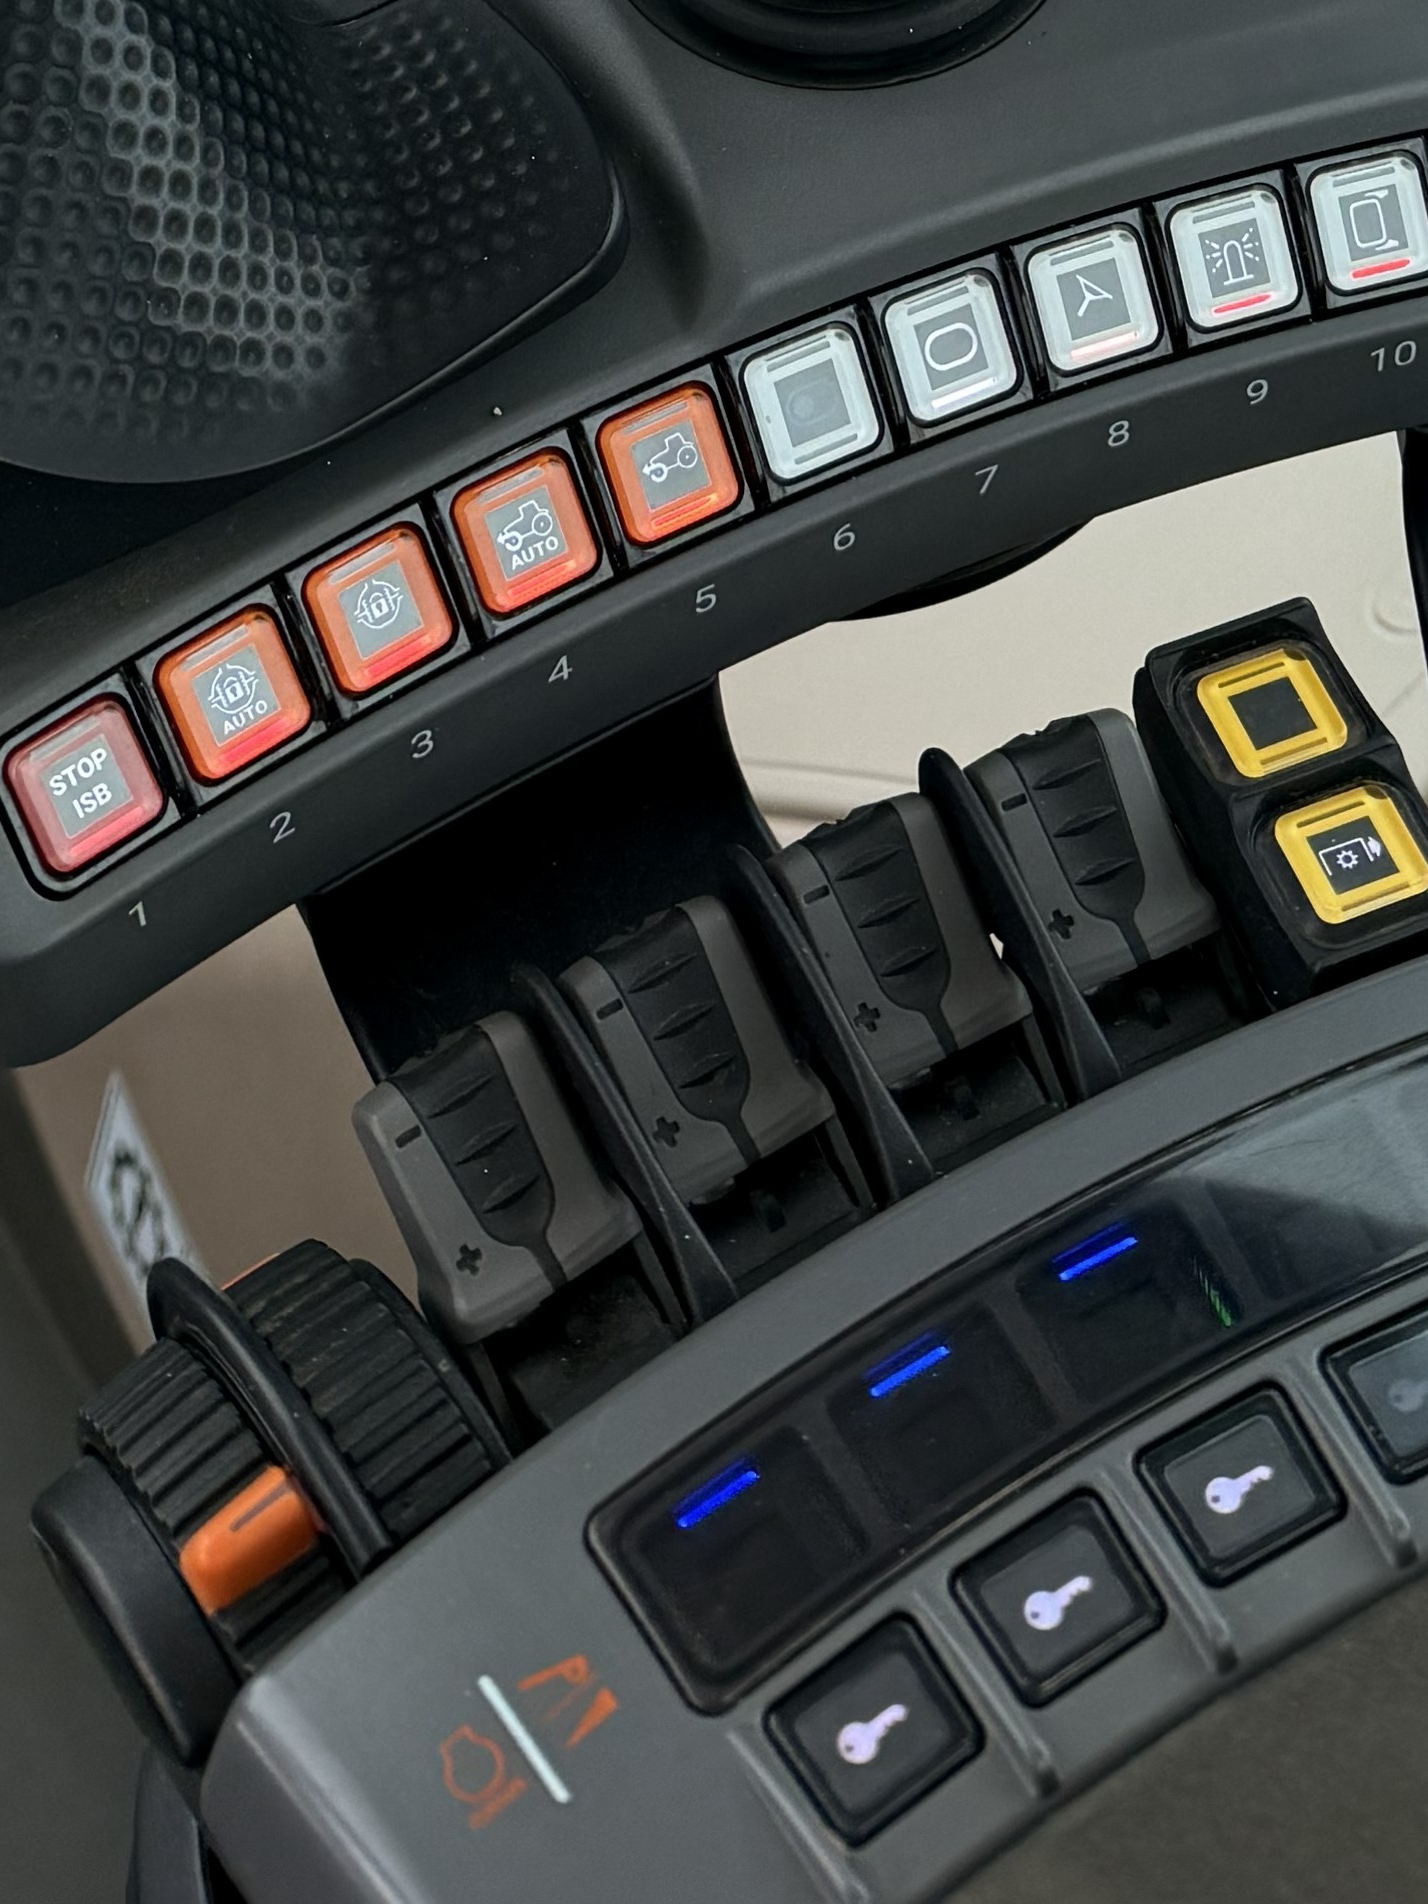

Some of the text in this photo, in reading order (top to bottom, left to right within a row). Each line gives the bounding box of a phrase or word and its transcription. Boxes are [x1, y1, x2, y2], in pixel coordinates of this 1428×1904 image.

[1370, 340, 1419, 373] 10
[1246, 379, 1270, 406] 9
[1106, 420, 1131, 448] 8
[974, 465, 1000, 494] 7
[832, 523, 856, 552] 6
[508, 534, 561, 573] AUTO
[694, 584, 718, 613] 5
[547, 655, 573, 683] 4
[224, 700, 268, 735] AUTO
[410, 729, 435, 760] 3
[48, 748, 107, 796] STOP
[73, 783, 112, 818] ISB
[270, 811, 296, 844] 2
[128, 901, 146, 926] 1
